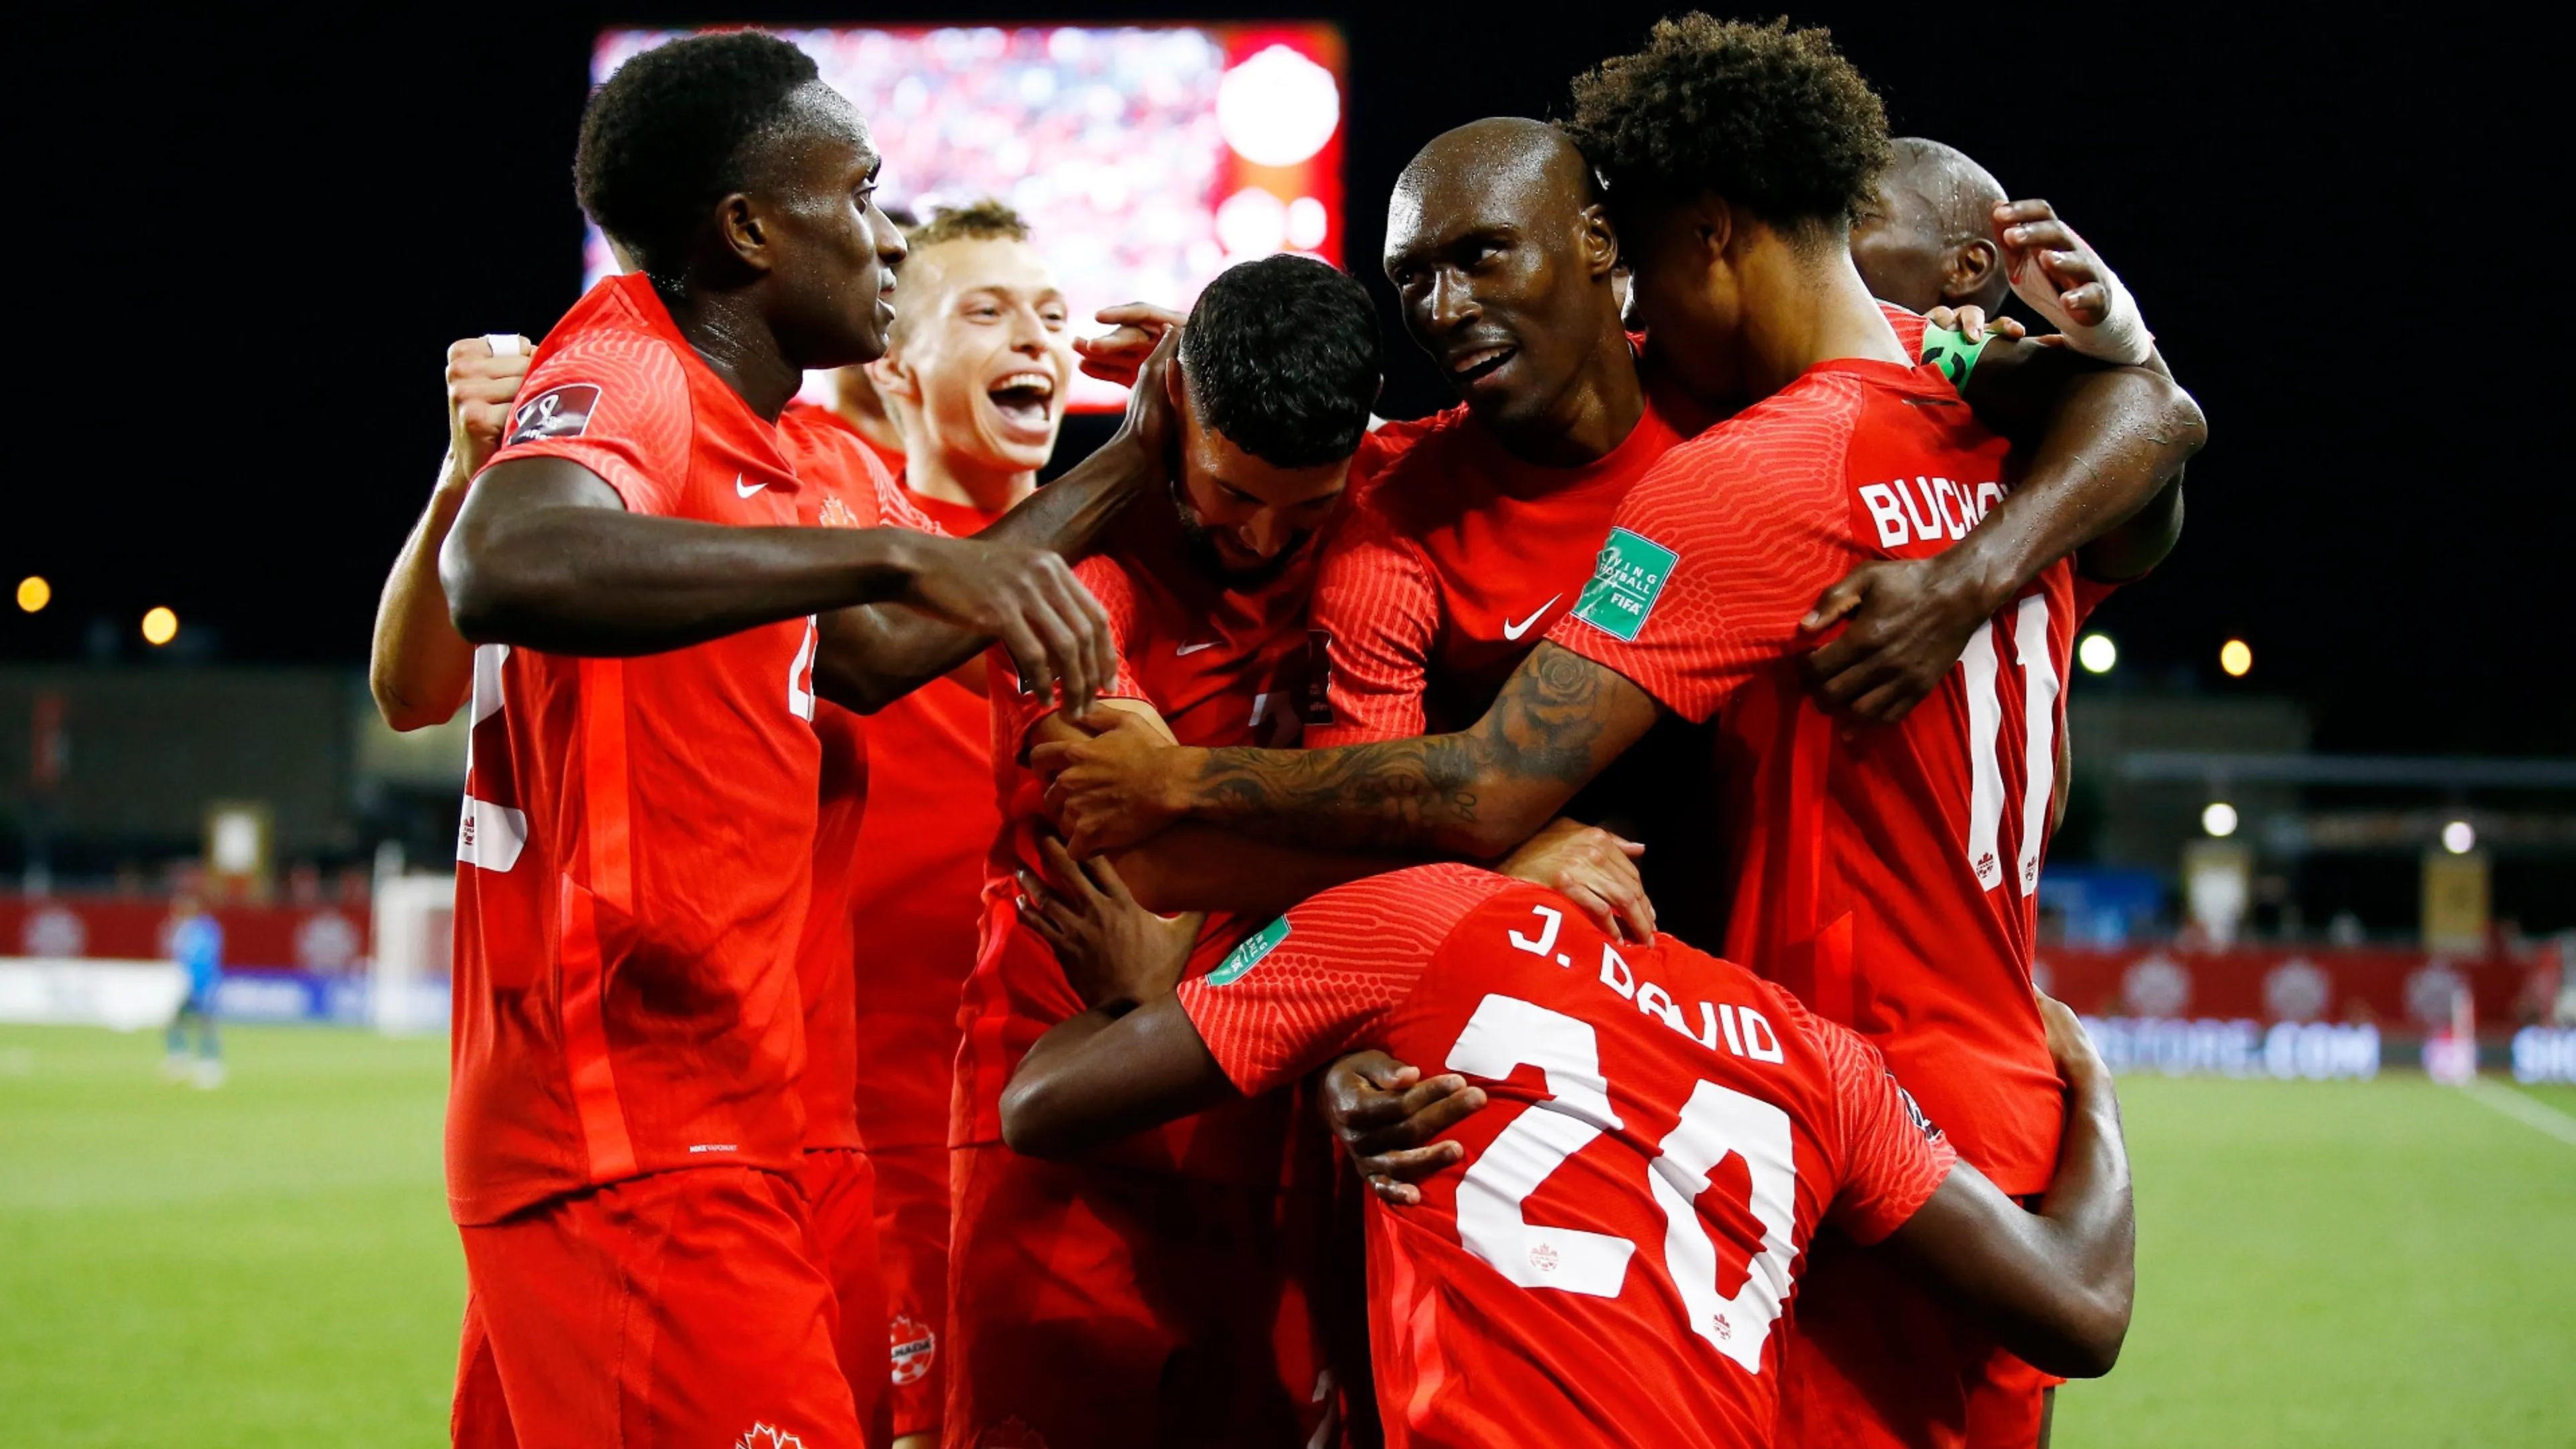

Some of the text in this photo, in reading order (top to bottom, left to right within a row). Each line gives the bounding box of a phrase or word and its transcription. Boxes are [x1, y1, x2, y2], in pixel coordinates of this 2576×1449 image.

[1858, 476, 2009, 548] BUCHA
[1611, 592, 1643, 616] FIFA
[1957, 593, 2059, 898] 11
[1508, 904, 1784, 1065] J. DAVID
[1445, 993, 1800, 1375] 20
